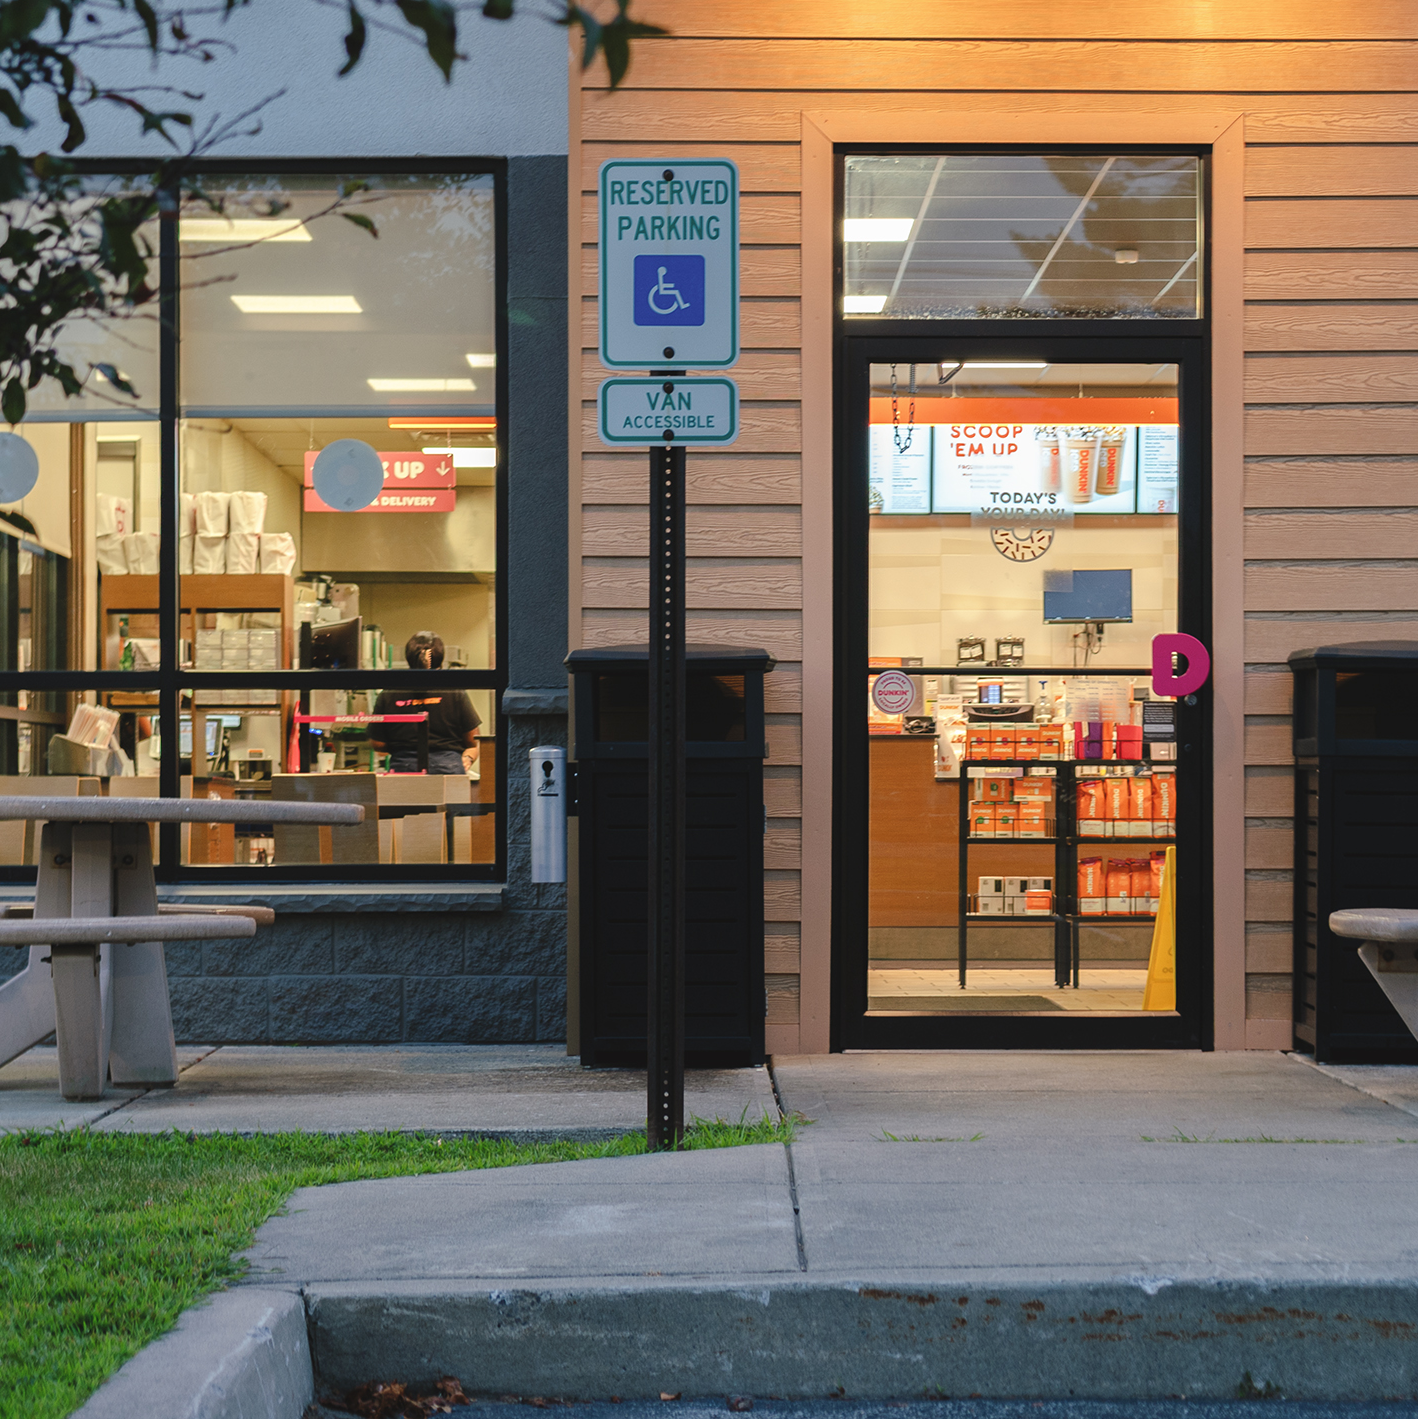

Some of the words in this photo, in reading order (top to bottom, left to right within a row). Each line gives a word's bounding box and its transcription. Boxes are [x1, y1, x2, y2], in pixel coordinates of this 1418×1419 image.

[610, 180, 729, 205] RESERVED
[618, 215, 721, 241] PARKING
[646, 392, 692, 411] VAN
[623, 415, 716, 429] ACCESSIBLE
[950, 425, 1023, 439] SCOOP
[950, 442, 985, 457] 'EM
[992, 443, 1018, 456] UP
[394, 461, 425, 479] UP
[381, 496, 437, 506] DELIVERY
[989, 491, 1057, 505] TODAY'S
[981, 506, 1025, 520] YOUR
[1029, 507, 1065, 520] DAY!
